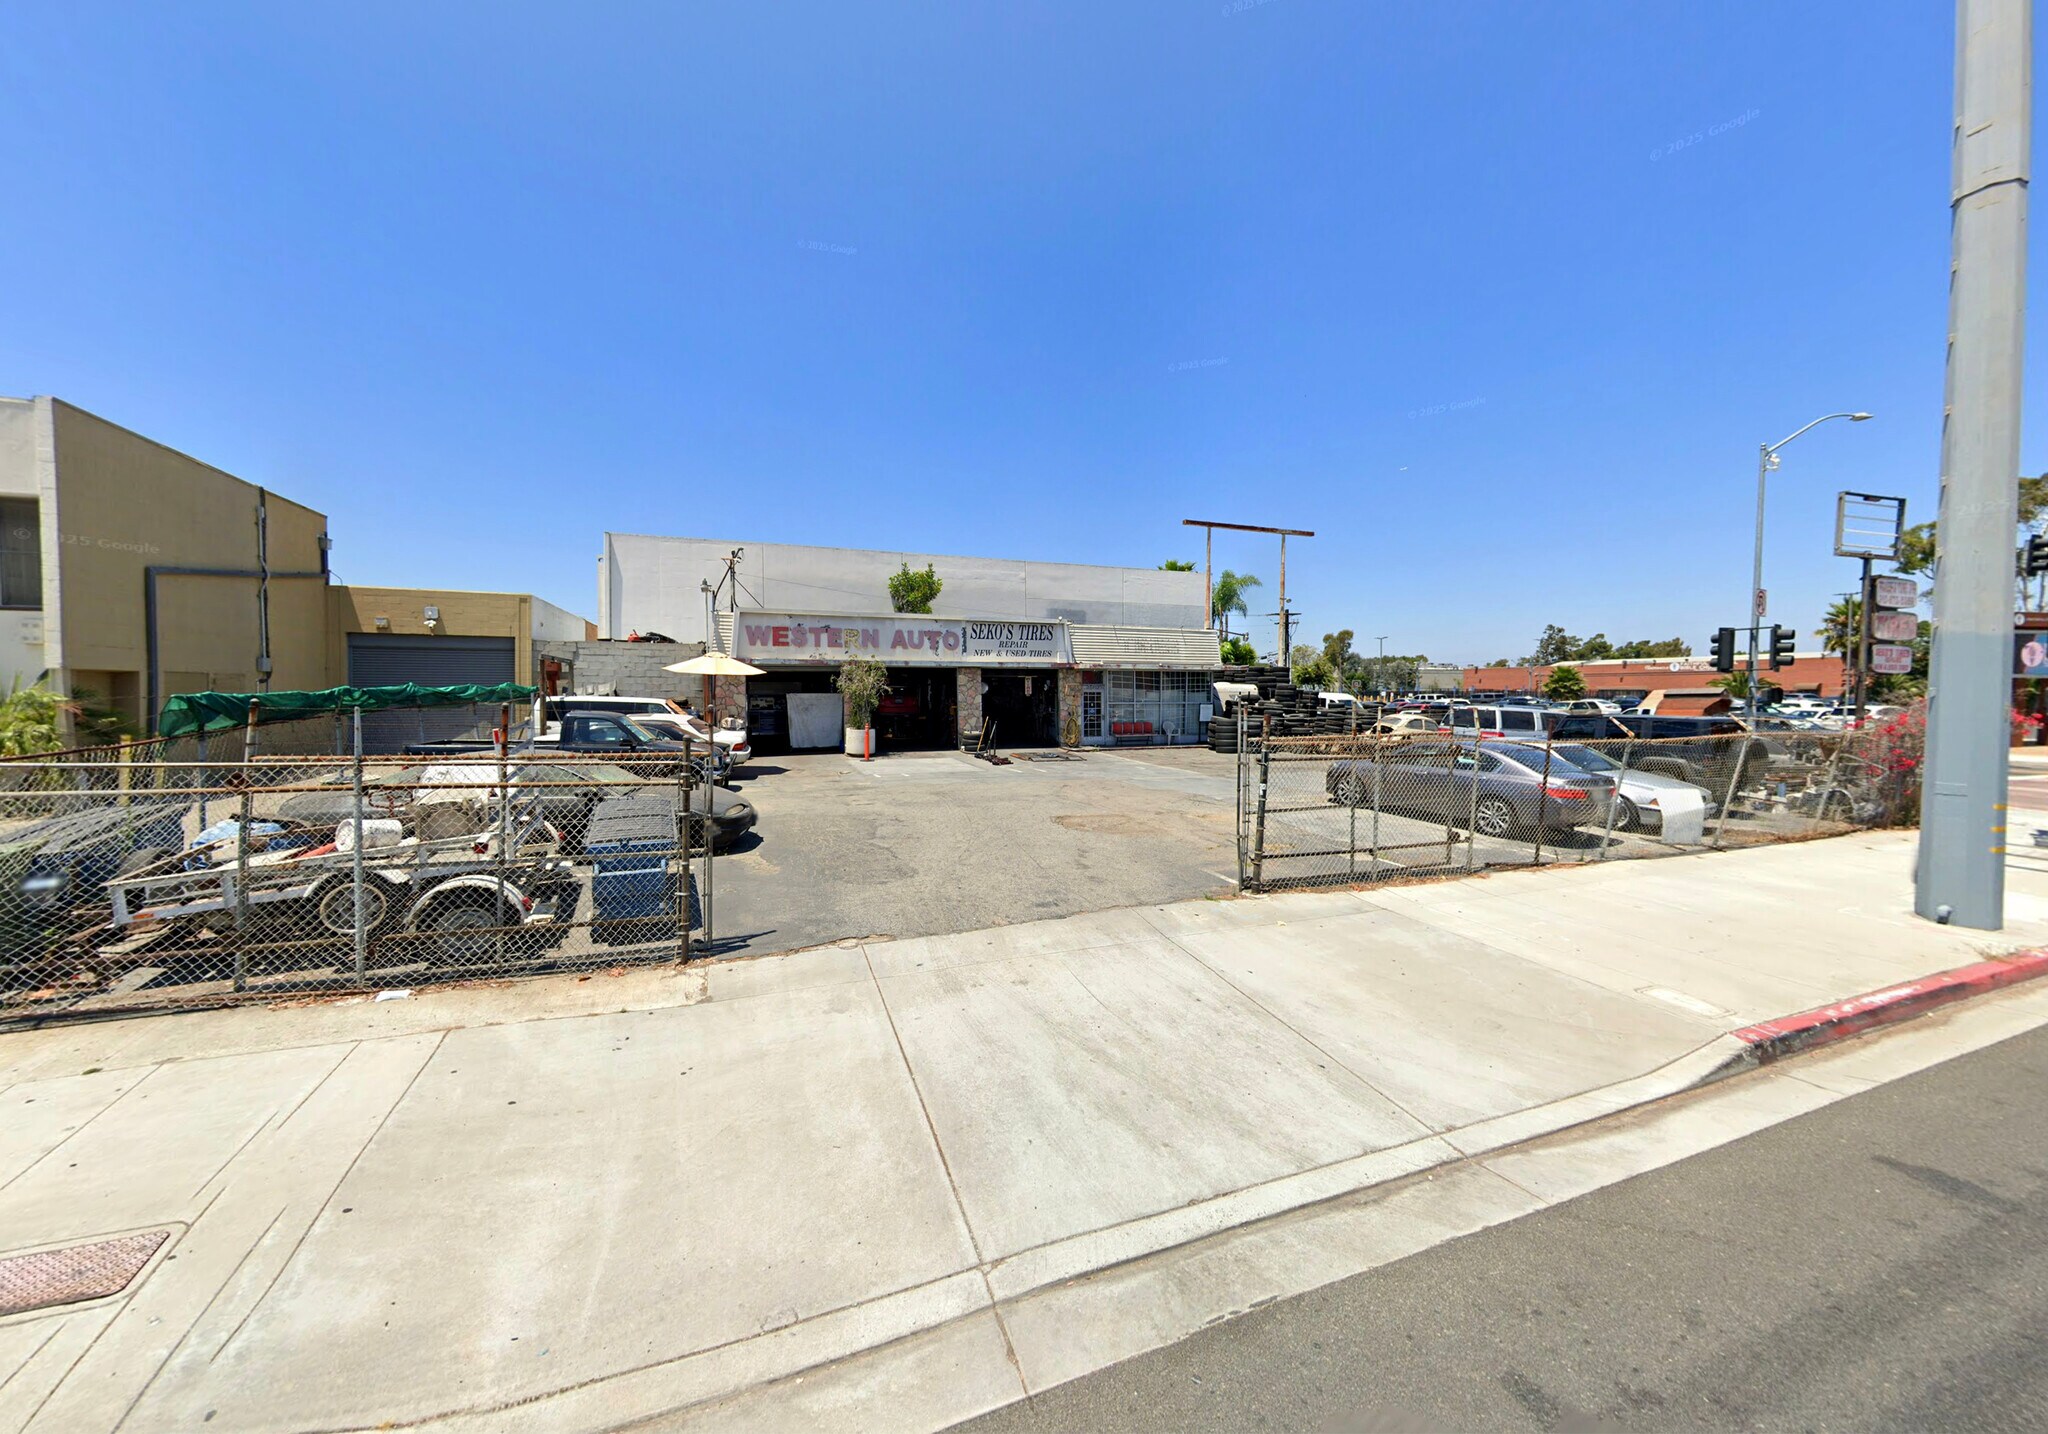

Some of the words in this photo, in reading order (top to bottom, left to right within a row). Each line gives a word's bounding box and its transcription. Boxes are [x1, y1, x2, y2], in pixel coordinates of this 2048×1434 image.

[745, 624, 880, 650] WESTERN
[890, 629, 960, 651] AUTO
[970, 622, 1014, 641] SEKO'S
[1018, 623, 1054, 642] TIRES
[998, 640, 1029, 649] REPAIR
[973, 649, 993, 657] NEW
[996, 649, 1003, 657] &
[1005, 649, 1026, 657] USED
[1028, 650, 1053, 658] TIRES
